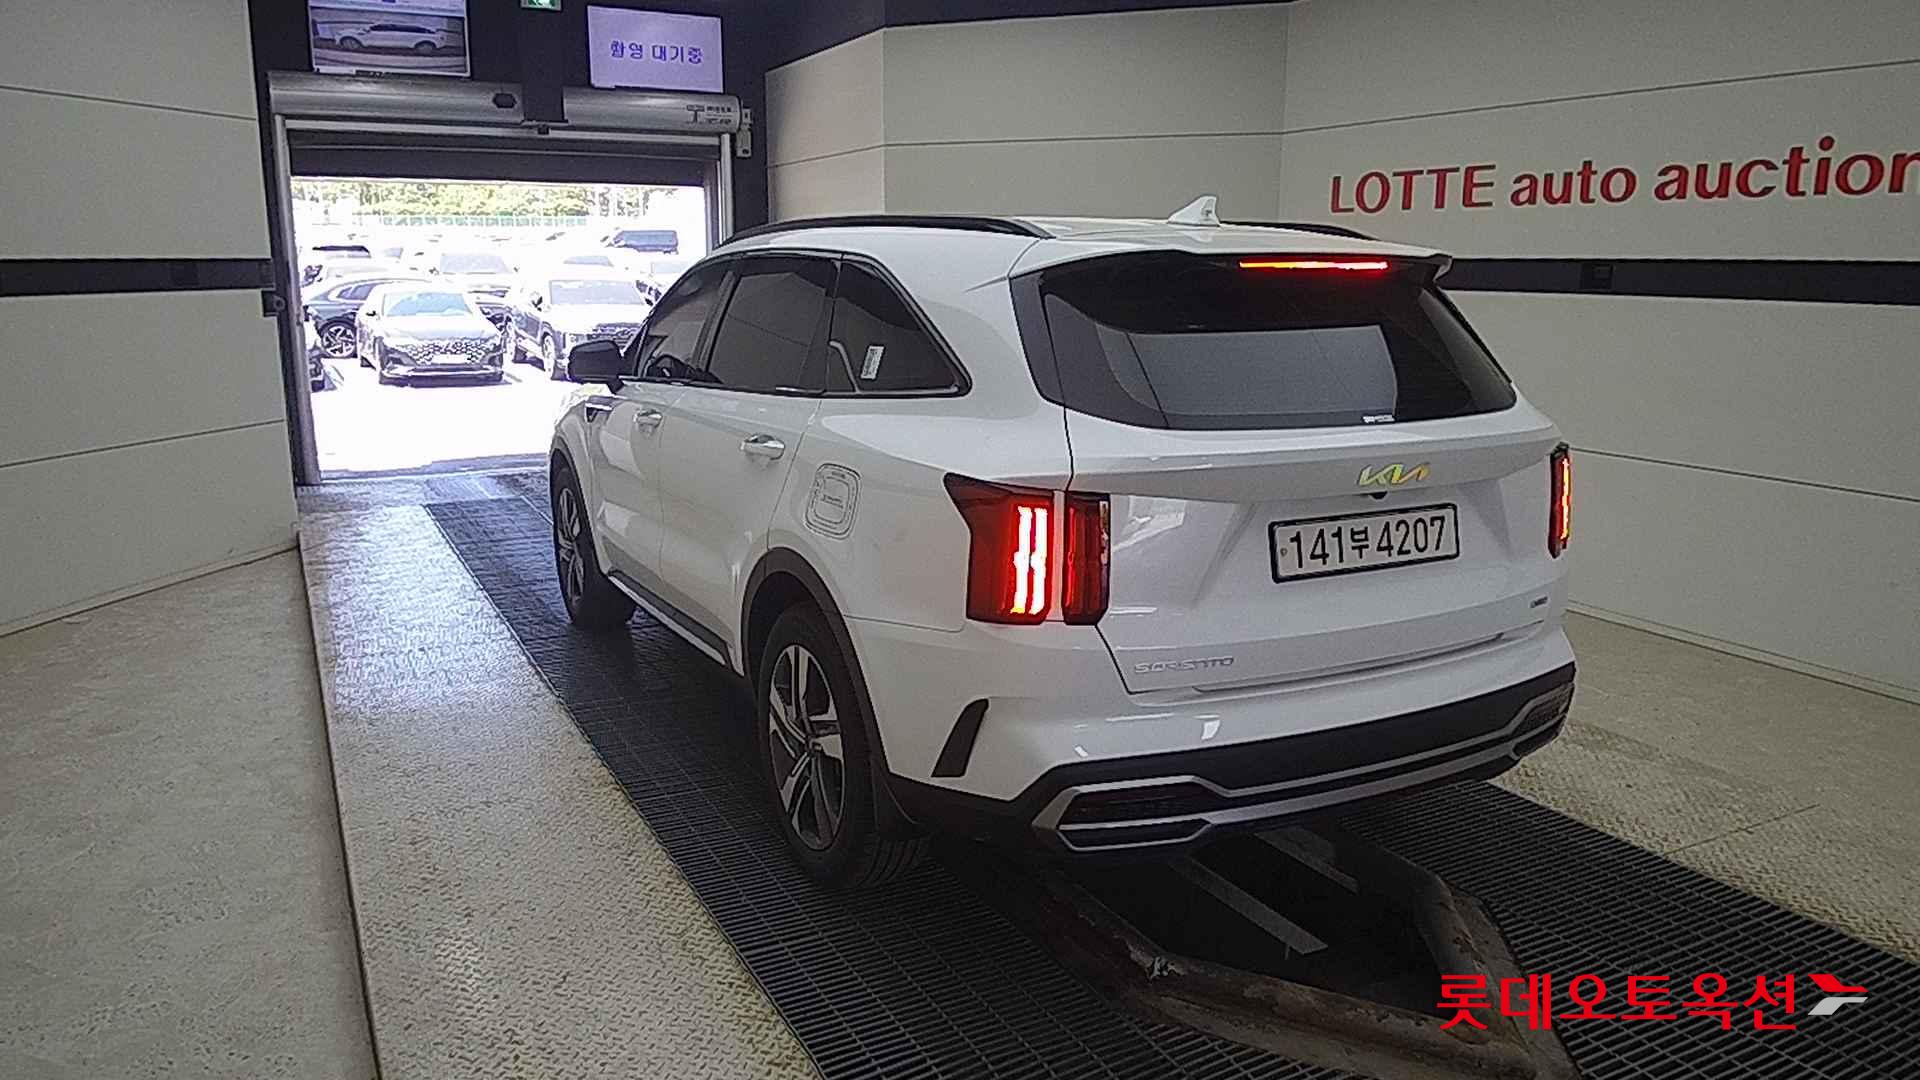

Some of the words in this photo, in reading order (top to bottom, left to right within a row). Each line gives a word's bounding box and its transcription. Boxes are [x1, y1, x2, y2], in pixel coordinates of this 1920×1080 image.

[652, 44, 703, 65] 대기중
[1330, 164, 1497, 214] LOTTE
[1510, 160, 1638, 207] auto
[1289, 515, 1447, 570] 141부4207
